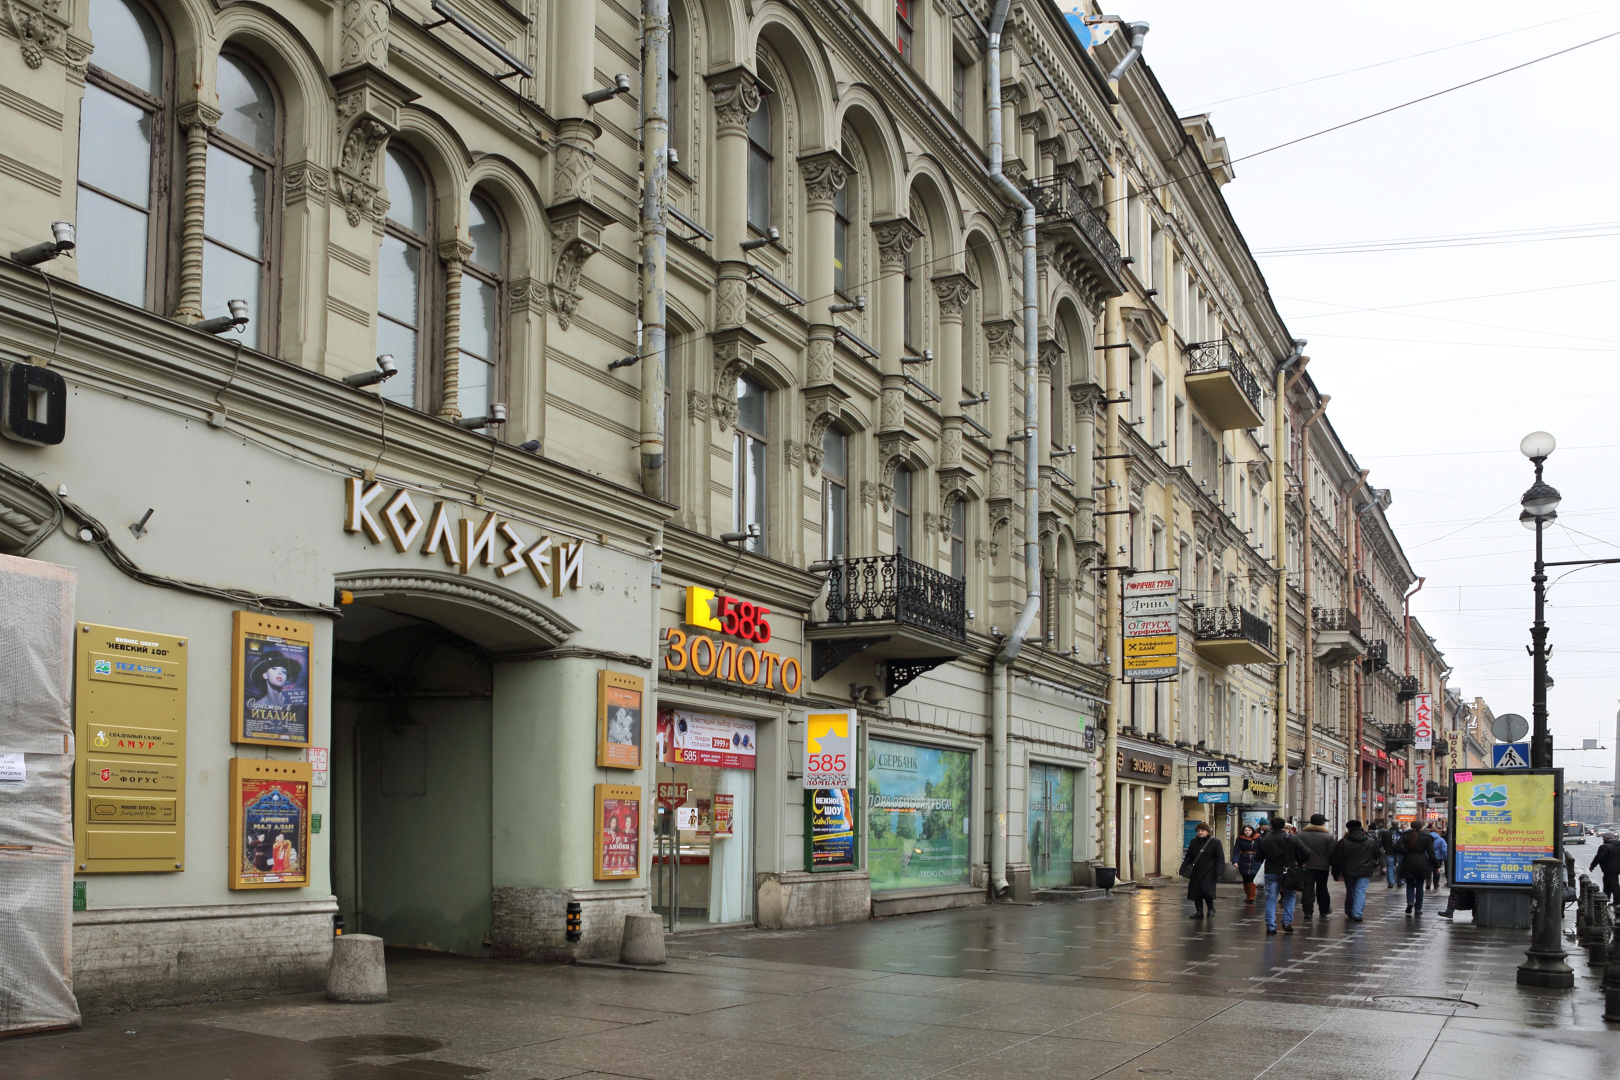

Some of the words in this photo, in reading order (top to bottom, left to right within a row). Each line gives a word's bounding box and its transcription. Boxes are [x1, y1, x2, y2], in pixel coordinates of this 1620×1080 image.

[344, 476, 585, 597] КОЛИЗЕЙ
[1126, 580, 1156, 590] ГОРЯЧИЕ
[1157, 580, 1174, 588] ТУРЫ
[717, 596, 771, 644] 585
[115, 662, 135, 671] TEZ
[664, 628, 802, 694] ЗОЛОТО
[1128, 668, 1174, 676] БАНКОМАТ
[251, 708, 297, 722] ИТАЛИИ
[1416, 695, 1431, 738] ТАКАО
[717, 718, 731, 728] выбор
[117, 740, 155, 749] АМУР
[684, 750, 697, 761] 585
[879, 753, 918, 769] СБЕРБАНК
[808, 754, 846, 771] 585
[660, 785, 686, 797] SALE
[825, 806, 842, 815] ШОУ
